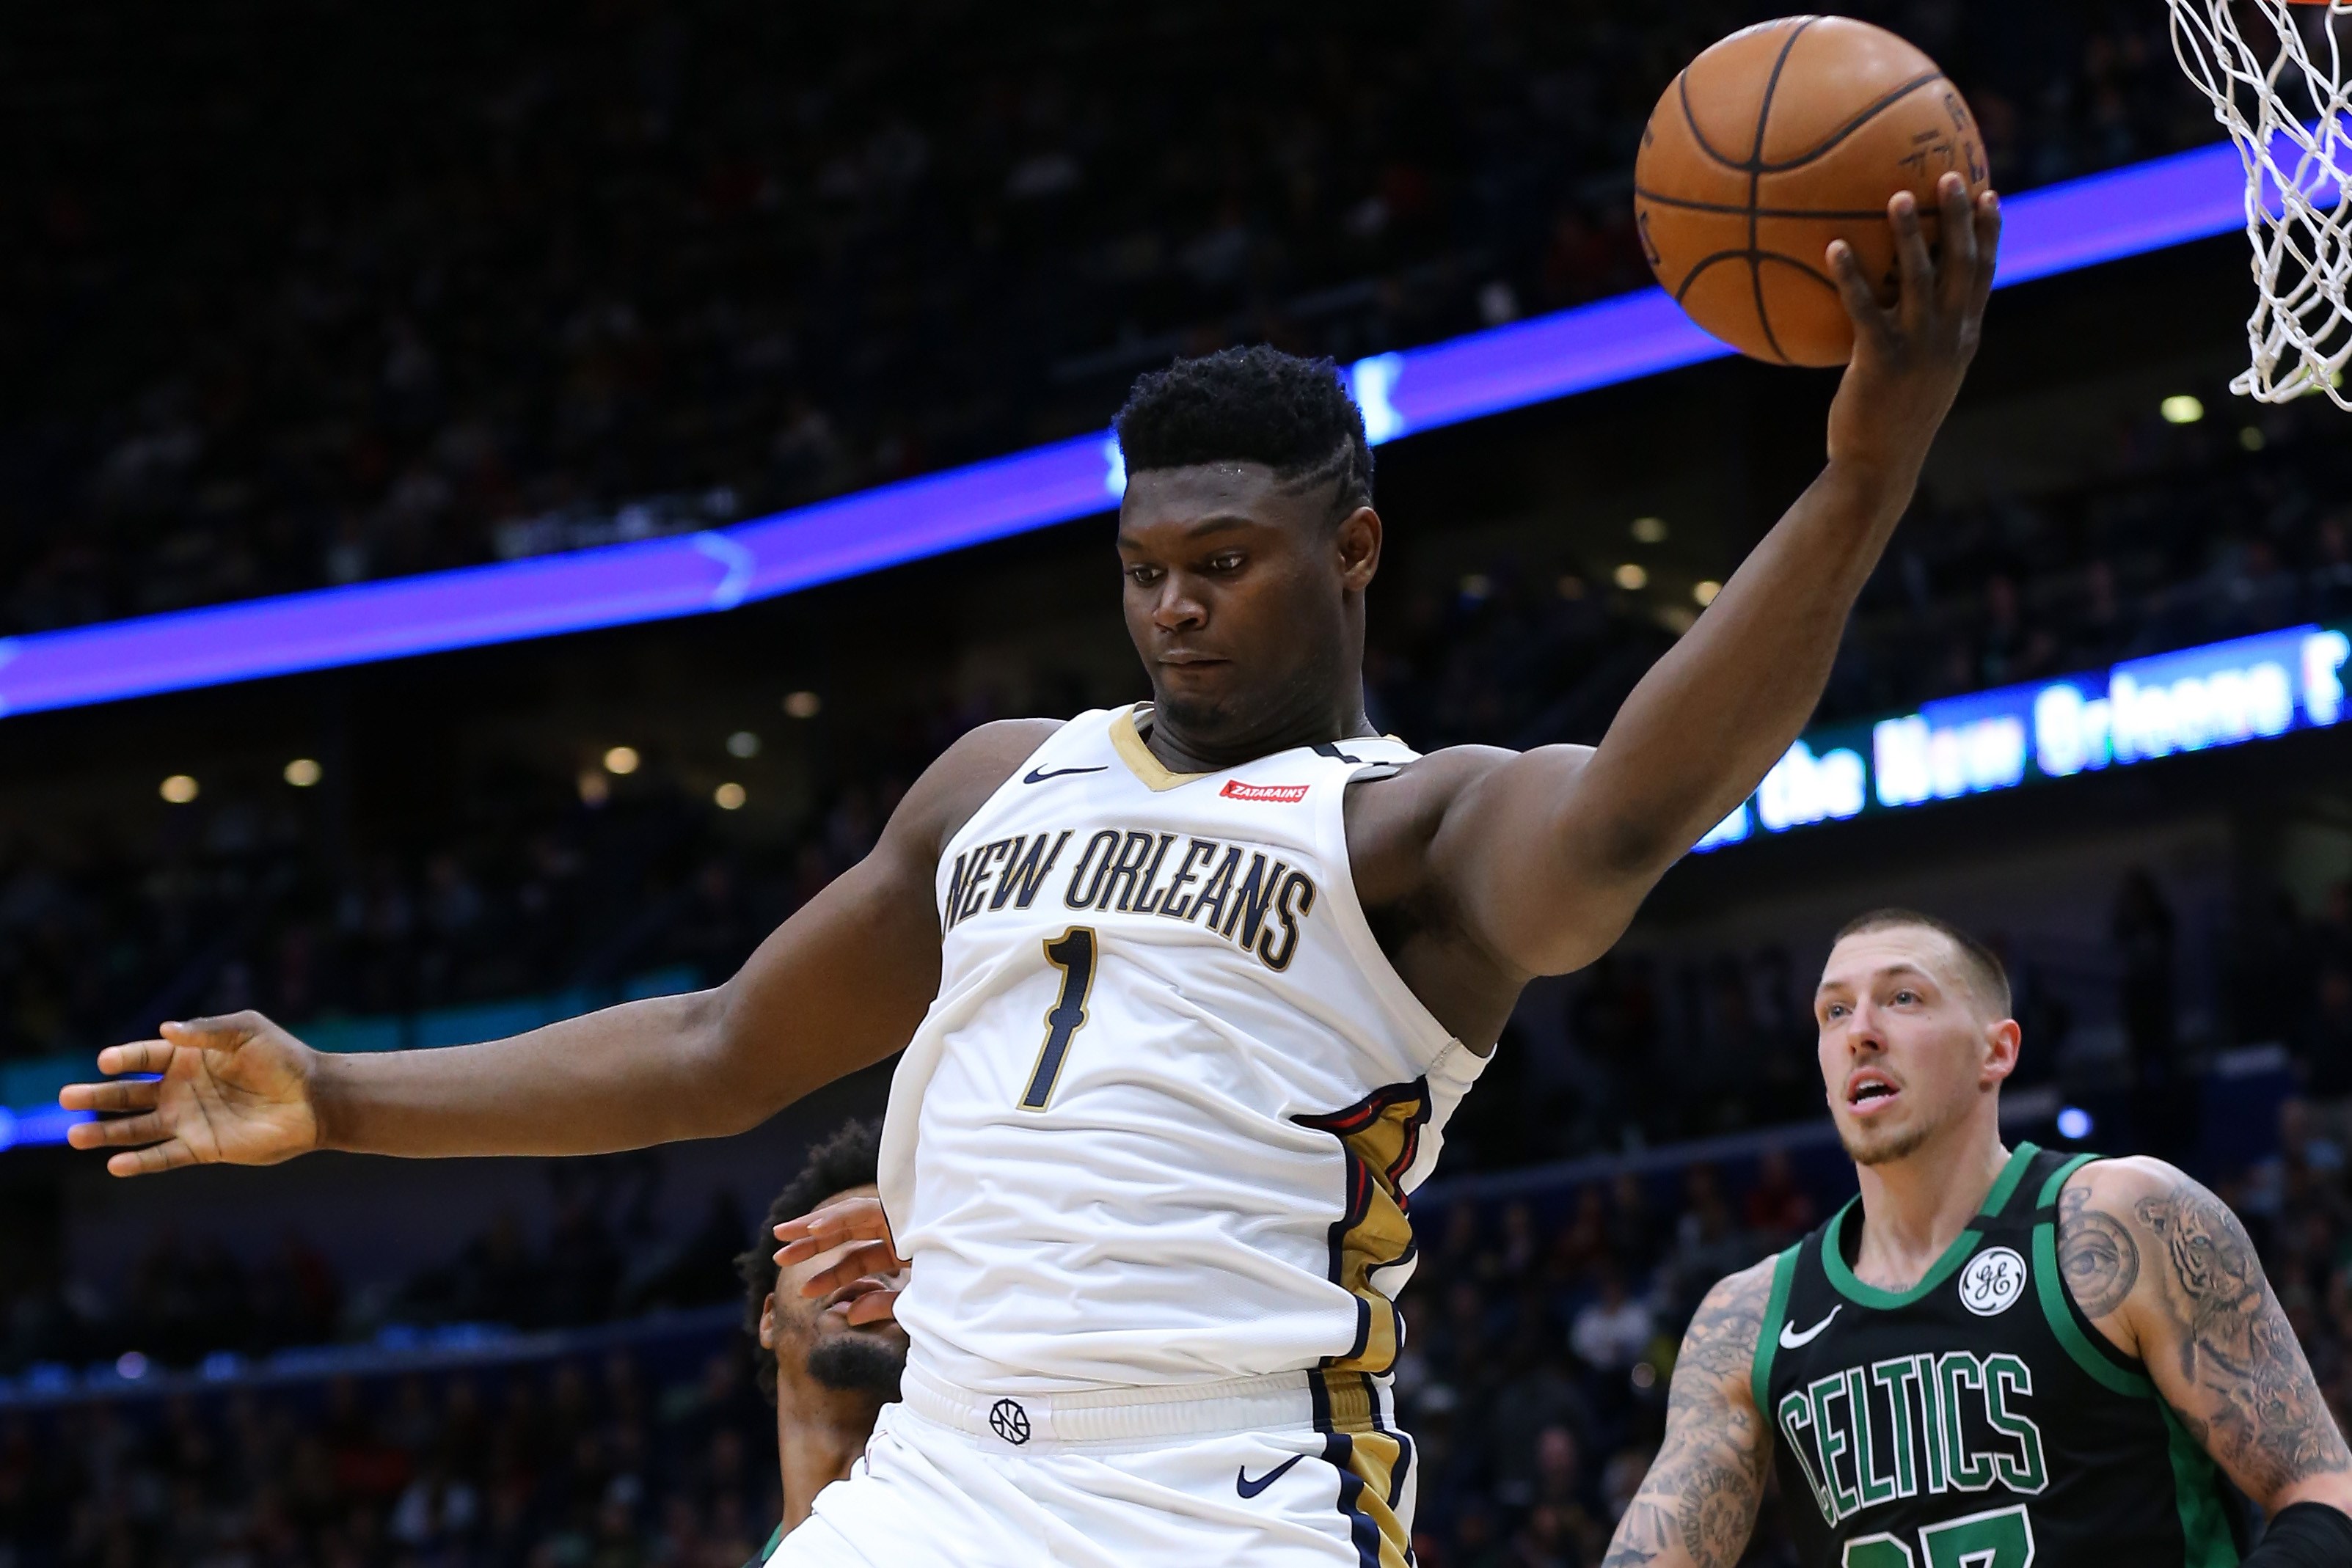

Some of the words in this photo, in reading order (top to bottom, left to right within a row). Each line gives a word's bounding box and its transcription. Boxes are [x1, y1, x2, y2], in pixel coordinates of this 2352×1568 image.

[1874, 713, 2026, 807] New
[942, 829, 1075, 946] NEW
[1063, 830, 1317, 972] ORLEANS
[1015, 925, 1098, 1113] 1
[1778, 1350, 2049, 1529] CELTICS
[1841, 1503, 2035, 1568] 7
